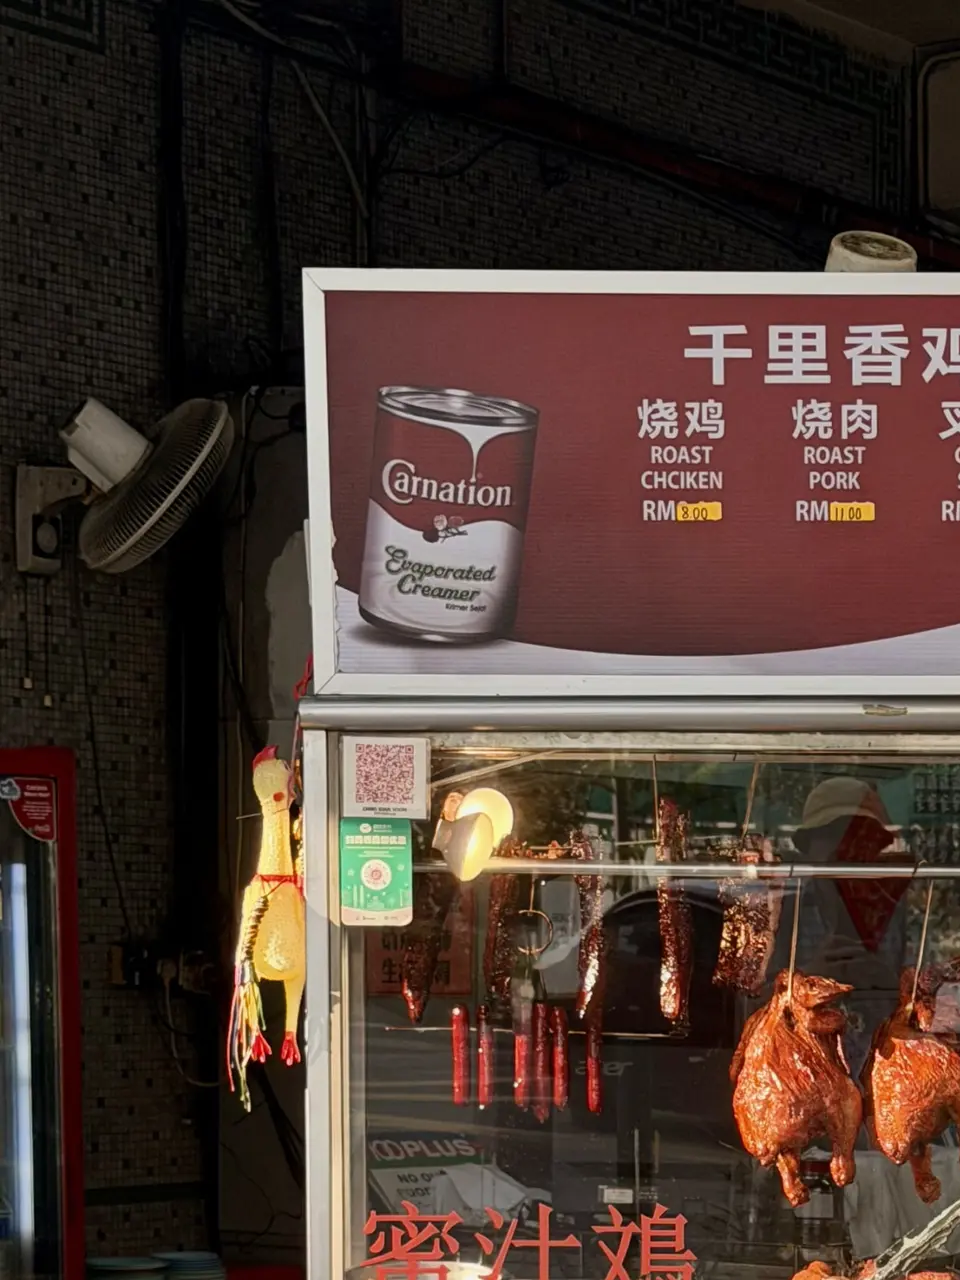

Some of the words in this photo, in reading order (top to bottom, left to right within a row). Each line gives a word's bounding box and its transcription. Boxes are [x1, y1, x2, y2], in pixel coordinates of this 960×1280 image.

[637, 398, 726, 440] 烧鸡
[791, 398, 878, 440] 烧肉
[651, 445, 713, 465] ROAST
[804, 445, 865, 465] ROAST
[381, 459, 512, 507] Carnation
[641, 471, 723, 490] CHCIKEN
[809, 471, 860, 490] PORK
[385, 545, 496, 584] Evaporated
[397, 576, 480, 603] Creamer
[575, 1060, 634, 1077] aer
